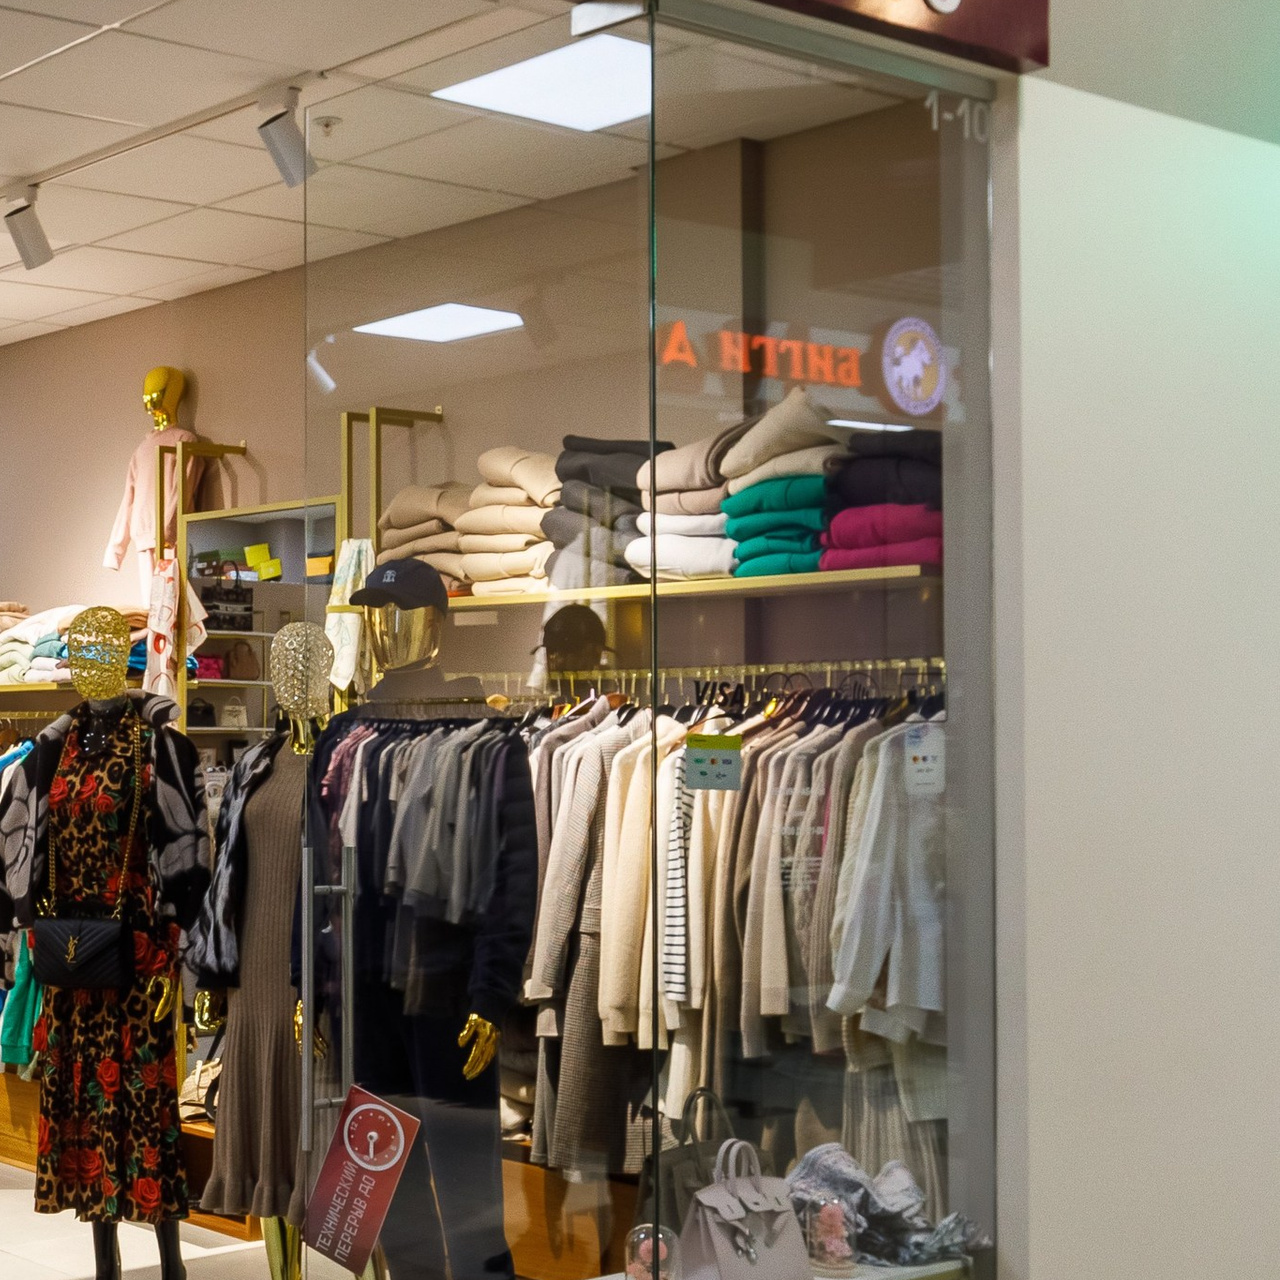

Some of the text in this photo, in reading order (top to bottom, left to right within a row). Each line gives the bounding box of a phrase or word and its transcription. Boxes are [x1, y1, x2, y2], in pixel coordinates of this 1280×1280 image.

[694, 680, 745, 711] VISA
[315, 1160, 359, 1252] ТЕХНИЧЕСКИЙ
[334, 1174, 376, 1263] ПЕРЕРЫВ ДО
